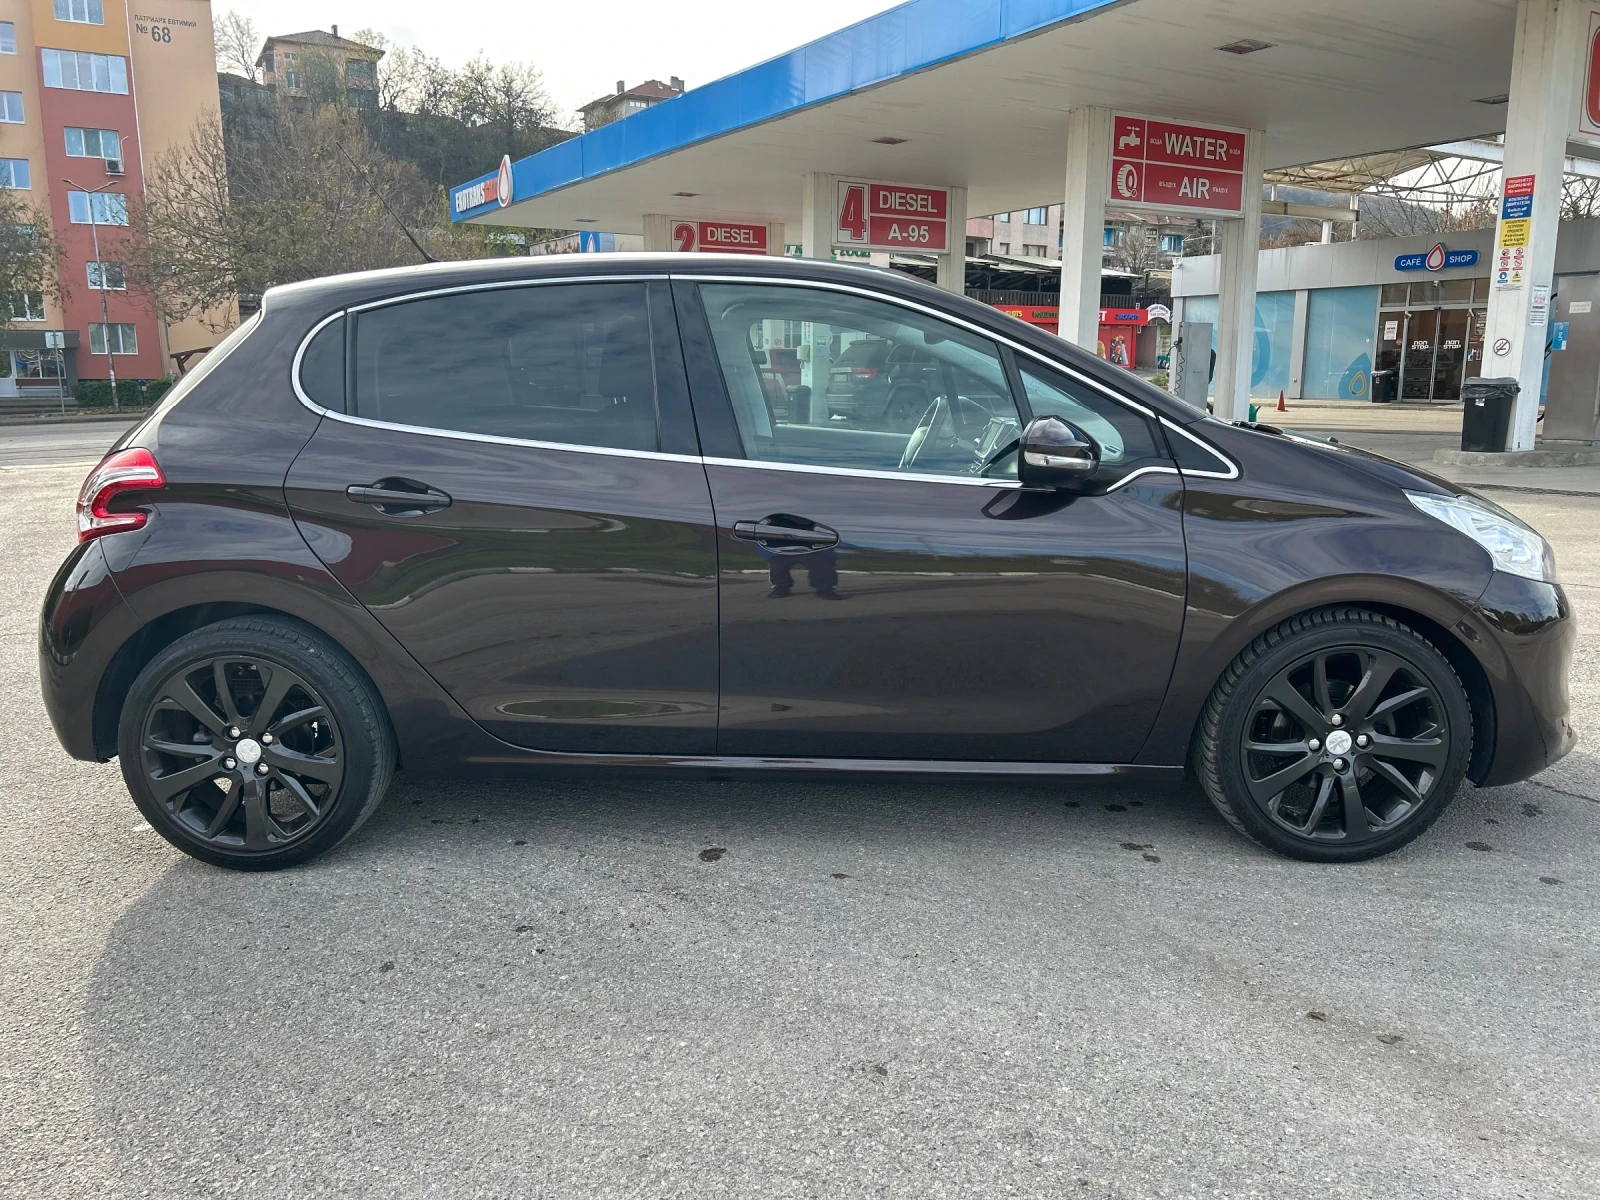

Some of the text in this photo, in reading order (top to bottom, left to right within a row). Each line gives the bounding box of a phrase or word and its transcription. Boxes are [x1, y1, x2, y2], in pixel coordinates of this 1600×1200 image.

[134, 15, 196, 28] ПАТРИАРХ ЕВТИМИЙ
[151, 25, 171, 43] 68
[1150, 137, 1162, 145] ВОДА
[1165, 132, 1227, 161] WATER
[1159, 180, 1176, 188] ВЪЗДУХ
[1178, 176, 1210, 200] AIR
[879, 190, 938, 213] DIESEL
[839, 185, 867, 241] 4
[674, 222, 697, 253] 2
[707, 227, 759, 244] DIESEL
[888, 223, 929, 243] A-95
[1400, 254, 1472, 267] CAFÉ SHOP
